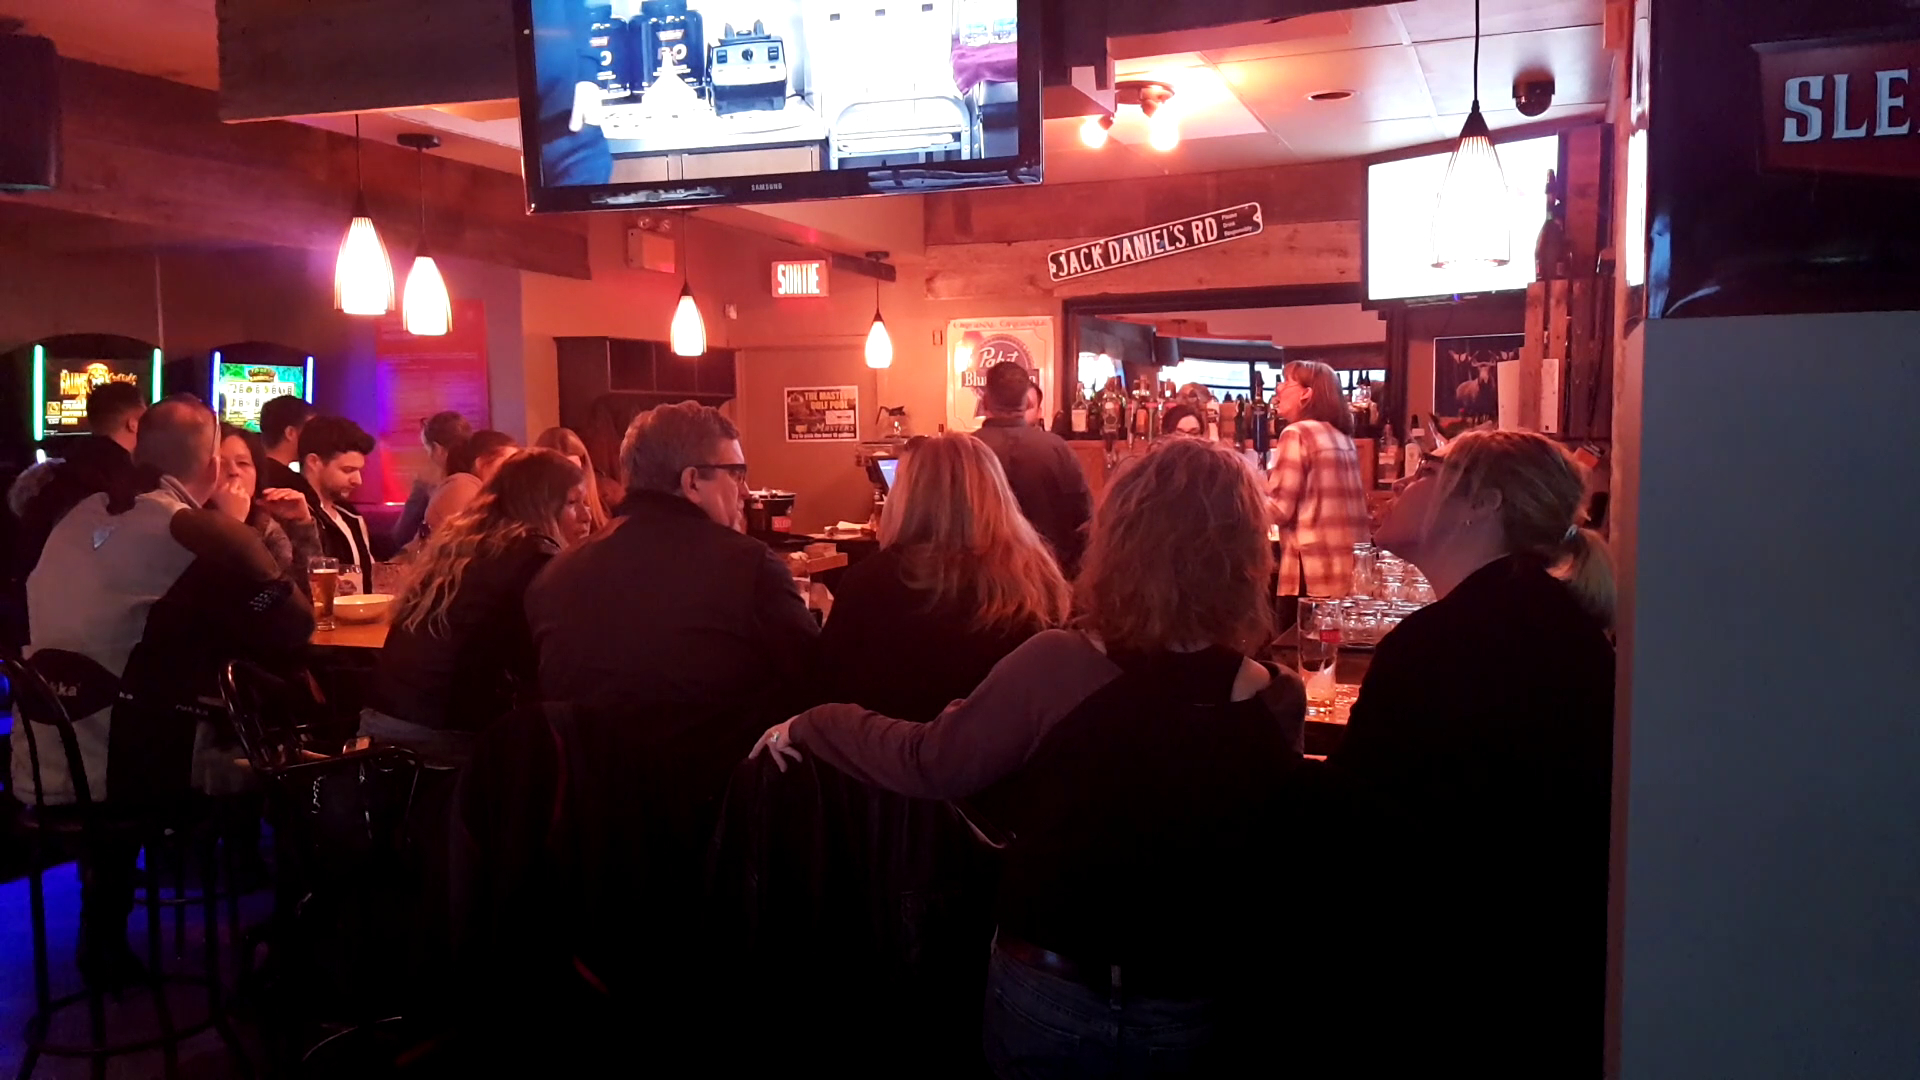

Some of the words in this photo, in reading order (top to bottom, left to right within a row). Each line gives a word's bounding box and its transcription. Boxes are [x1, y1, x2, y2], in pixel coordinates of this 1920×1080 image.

[1782, 69, 1920, 143] SLE
[751, 183, 783, 191] SAMSUNG
[1059, 243, 1104, 277] JACK
[1108, 225, 1186, 265] DANIEL'S
[1192, 216, 1218, 245] RD
[777, 263, 820, 295] SORTIE
[804, 391, 818, 401] THE
[829, 400, 849, 410] POOL
